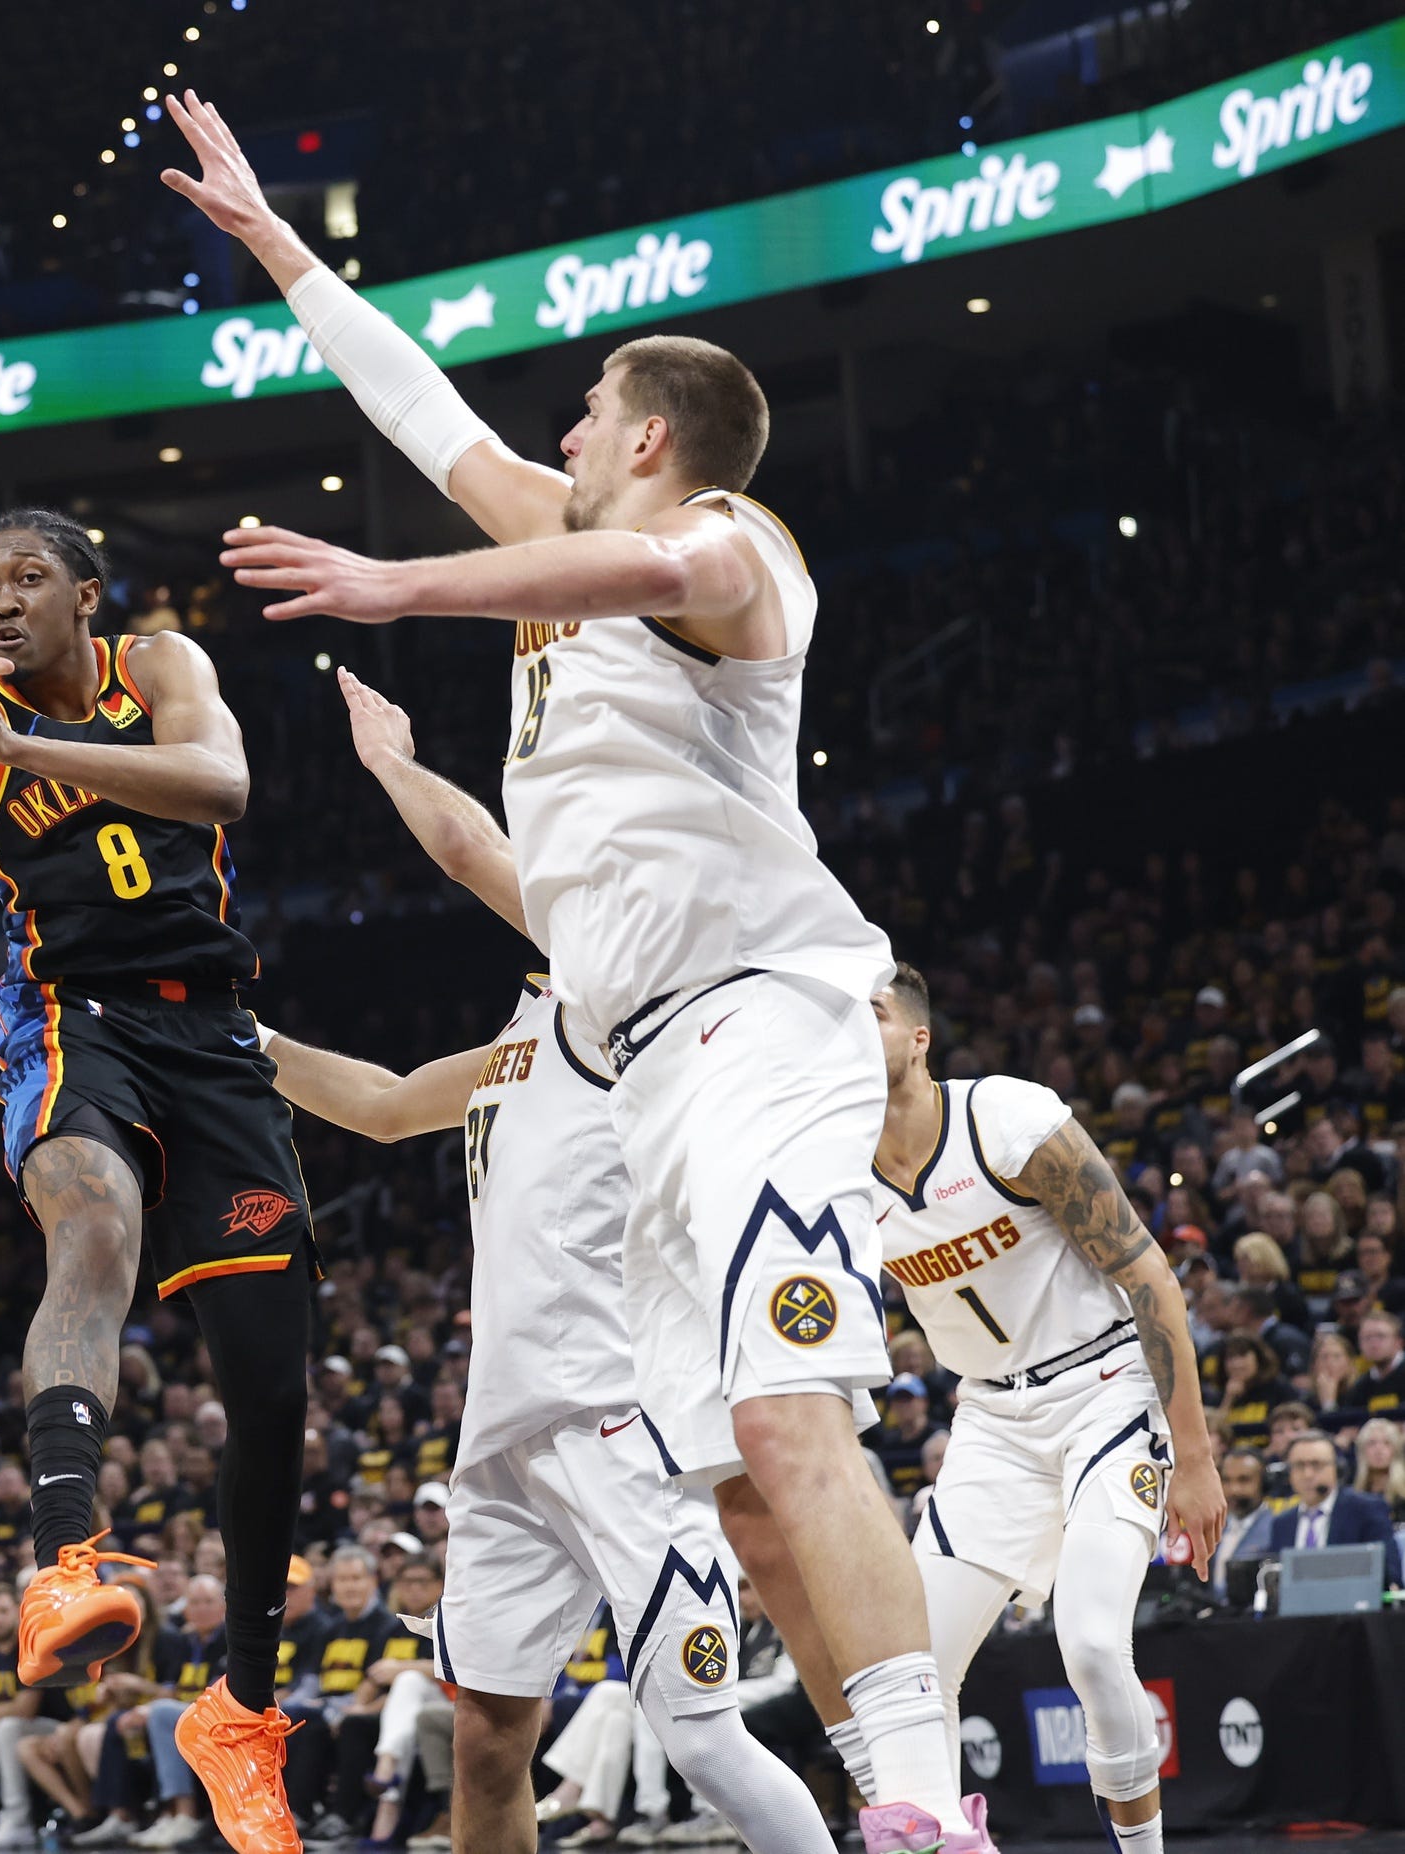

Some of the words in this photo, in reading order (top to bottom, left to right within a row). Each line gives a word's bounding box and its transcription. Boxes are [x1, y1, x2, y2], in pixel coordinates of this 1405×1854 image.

[1212, 55, 1373, 178] Sprite
[871, 152, 1060, 263] Sprite
[537, 232, 712, 338] Sprite
[96, 823, 152, 900] 8
[934, 1176, 976, 1201] ibotta
[882, 1214, 1021, 1287] NUGGETS
[955, 1286, 1010, 1345] 1
